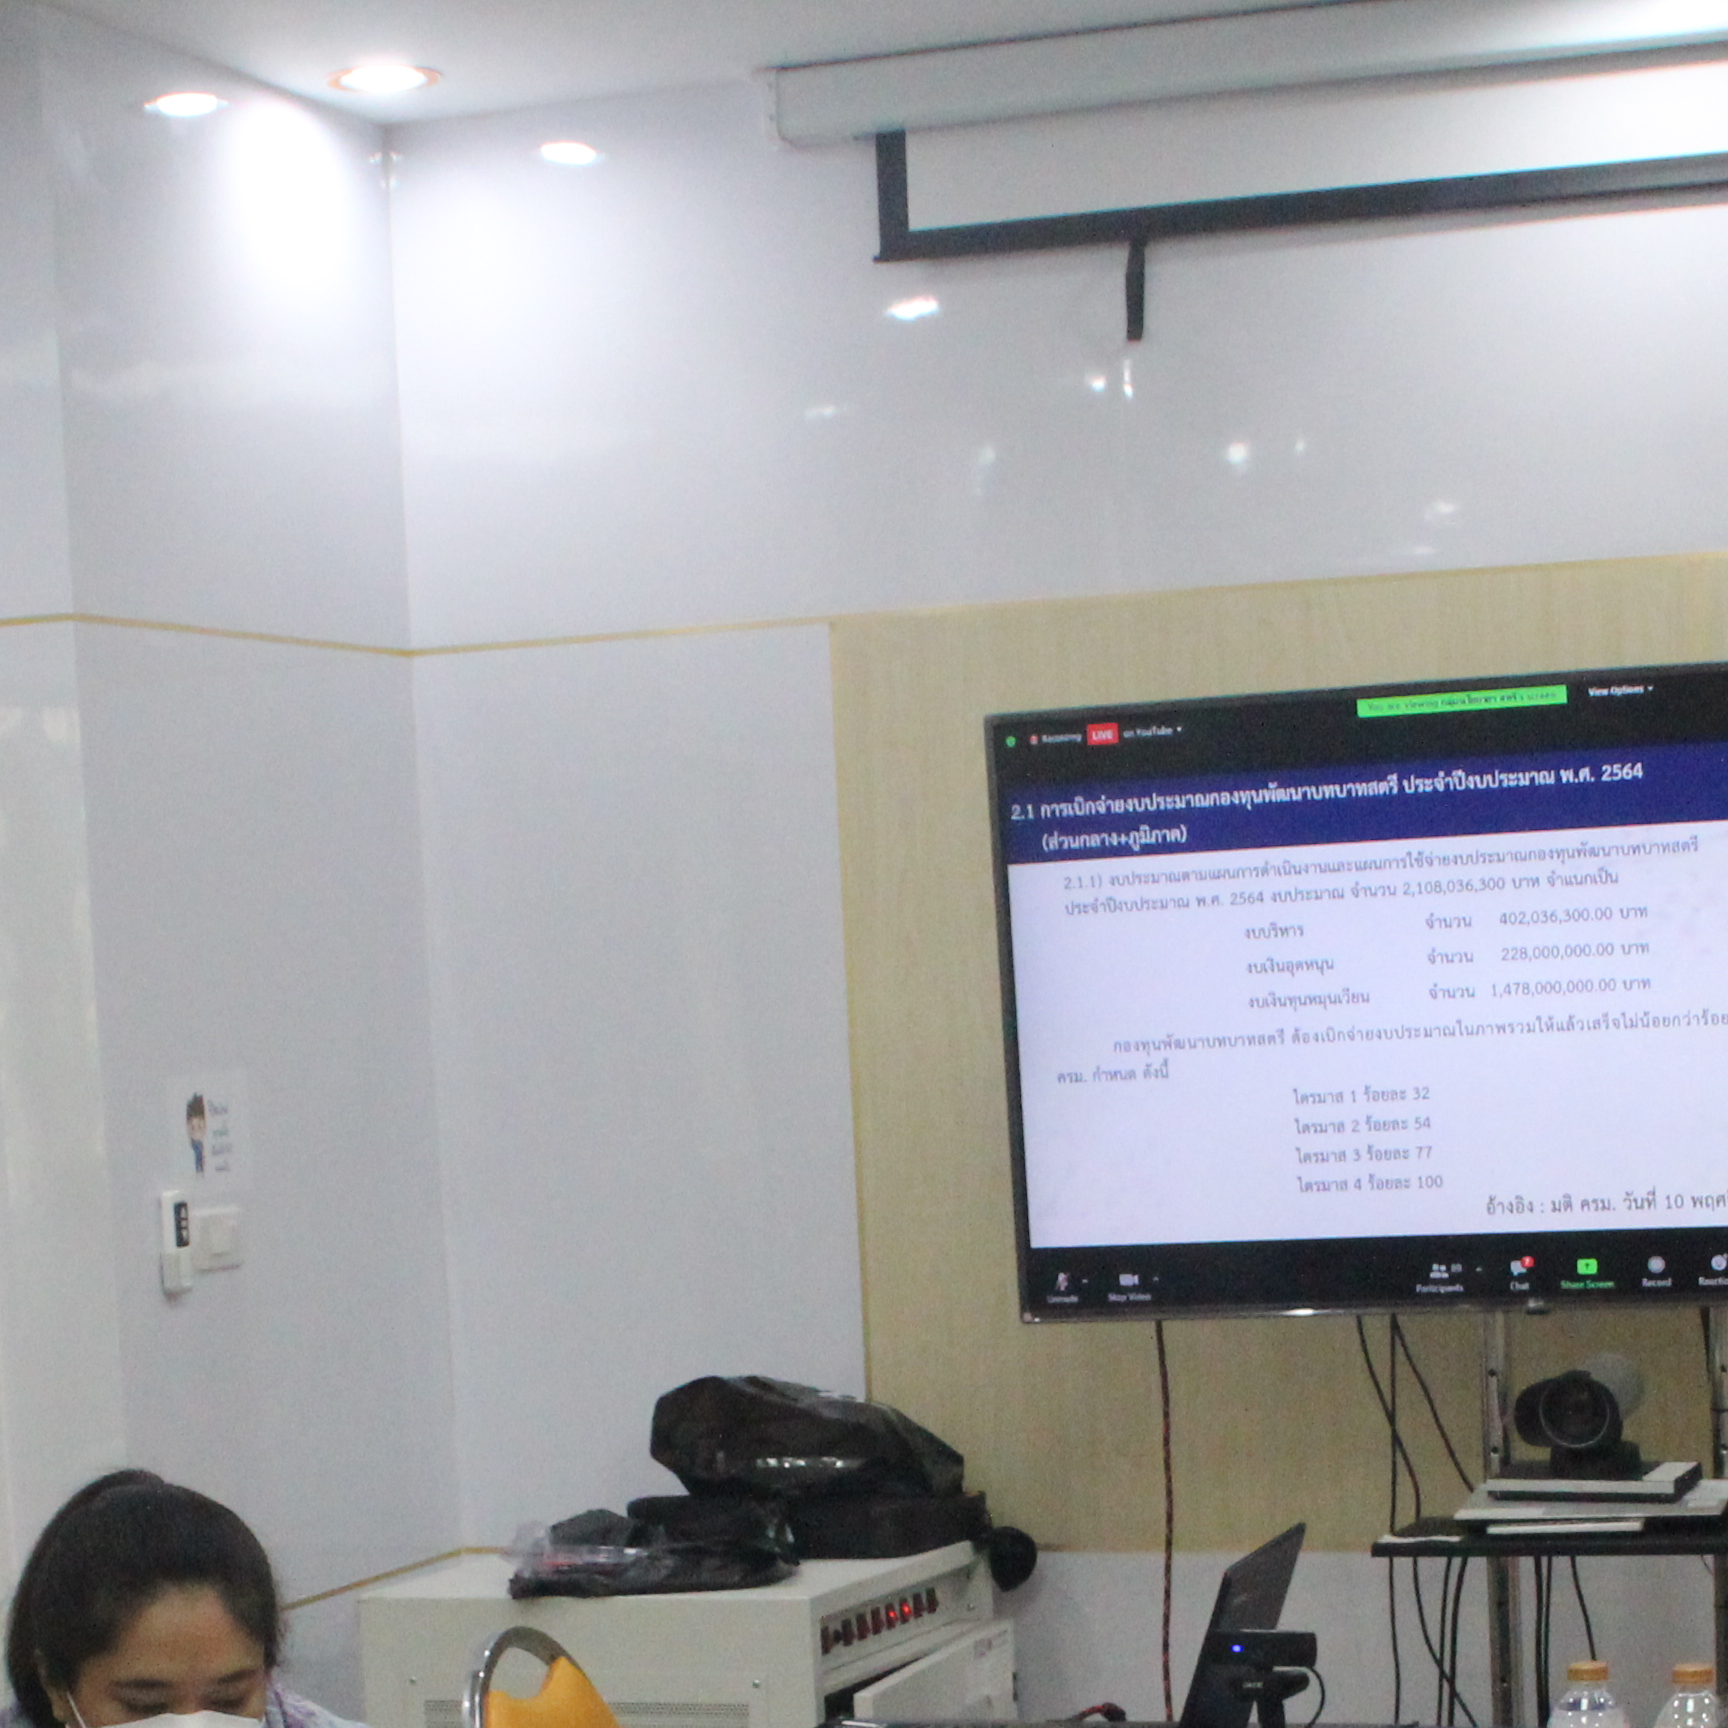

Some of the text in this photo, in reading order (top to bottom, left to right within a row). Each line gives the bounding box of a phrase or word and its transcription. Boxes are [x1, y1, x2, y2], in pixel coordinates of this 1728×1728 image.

[1091, 729, 1114, 740] LIVE
[1136, 725, 1173, 737] YouTube
[1010, 803, 1035, 820] 2.1
[1403, 767, 1556, 796] ประจำปีงบประมาณ
[1560, 766, 1595, 784] พ.ศ.
[1600, 762, 1644, 782] 2564
[1063, 873, 1104, 890] 2.1.1)
[1229, 890, 1265, 907] 2564
[1270, 886, 1345, 904] งบประมาณ
[1350, 881, 1397, 899] จำนวน
[1402, 876, 1506, 898] 2,108,036,300
[1511, 874, 1540, 890] บาท
[1547, 870, 1619, 888] จำแนกเป็น
[1243, 904, 1649, 940] งบบริหาร จำนวน 402,036,300.00 บาท
[1246, 940, 1650, 977] งบเงินอุดหนุน จำนวน 228,000,000.00 บาท
[1428, 981, 1476, 1001] จำนวน
[1491, 977, 1617, 999] 1,478,000,000.00
[1622, 976, 1652, 992] บาท
[1293, 1088, 1345, 1106] ไตรมาส
[1364, 1084, 1407, 1103] ร้อยละ
[1412, 1086, 1430, 1101] 32
[1294, 1114, 1431, 1135] ไตรมาส 2 ร้อยละ 54
[1295, 1144, 1433, 1164] ไตรมาส 3 ร้อยละ 77
[1297, 1173, 1444, 1193] ไตรมาส 4 ร้อยละ 100
[1485, 1193, 1535, 1216] อ้างอิง
[1550, 1192, 1574, 1214] มติ
[1580, 1196, 1617, 1212] ครม.
[1624, 1186, 1657, 1211] วันที่
[1665, 1194, 1685, 1210] 10
[1509, 1279, 1530, 1291] Chat
[1641, 1277, 1672, 1288] Record
